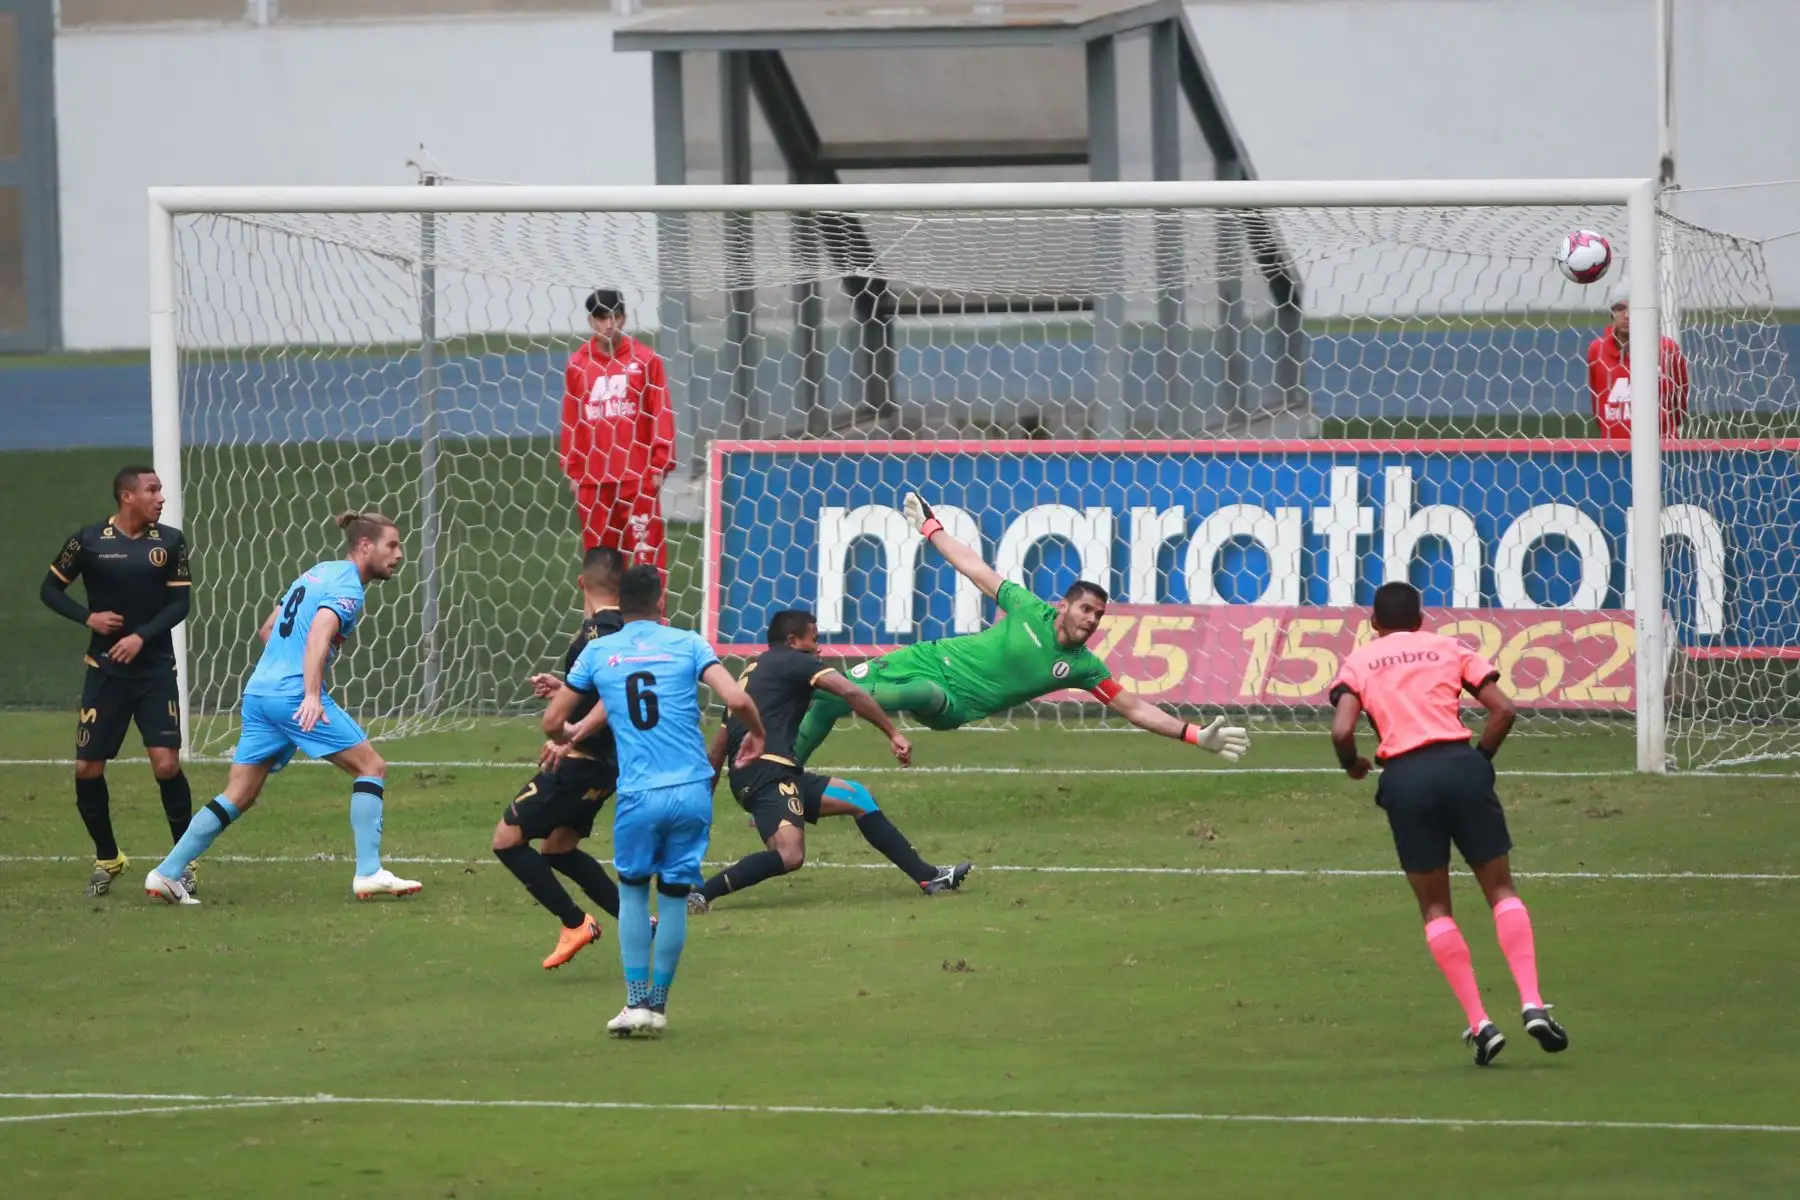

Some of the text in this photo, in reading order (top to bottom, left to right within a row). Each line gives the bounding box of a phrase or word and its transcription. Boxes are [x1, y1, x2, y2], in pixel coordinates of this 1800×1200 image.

[817, 464, 1725, 636] marathon
[278, 585, 306, 639] 9
[1066, 614, 1195, 696] 75
[1368, 650, 1440, 671] umbro
[167, 699, 178, 727] 4
[625, 670, 659, 731] 6
